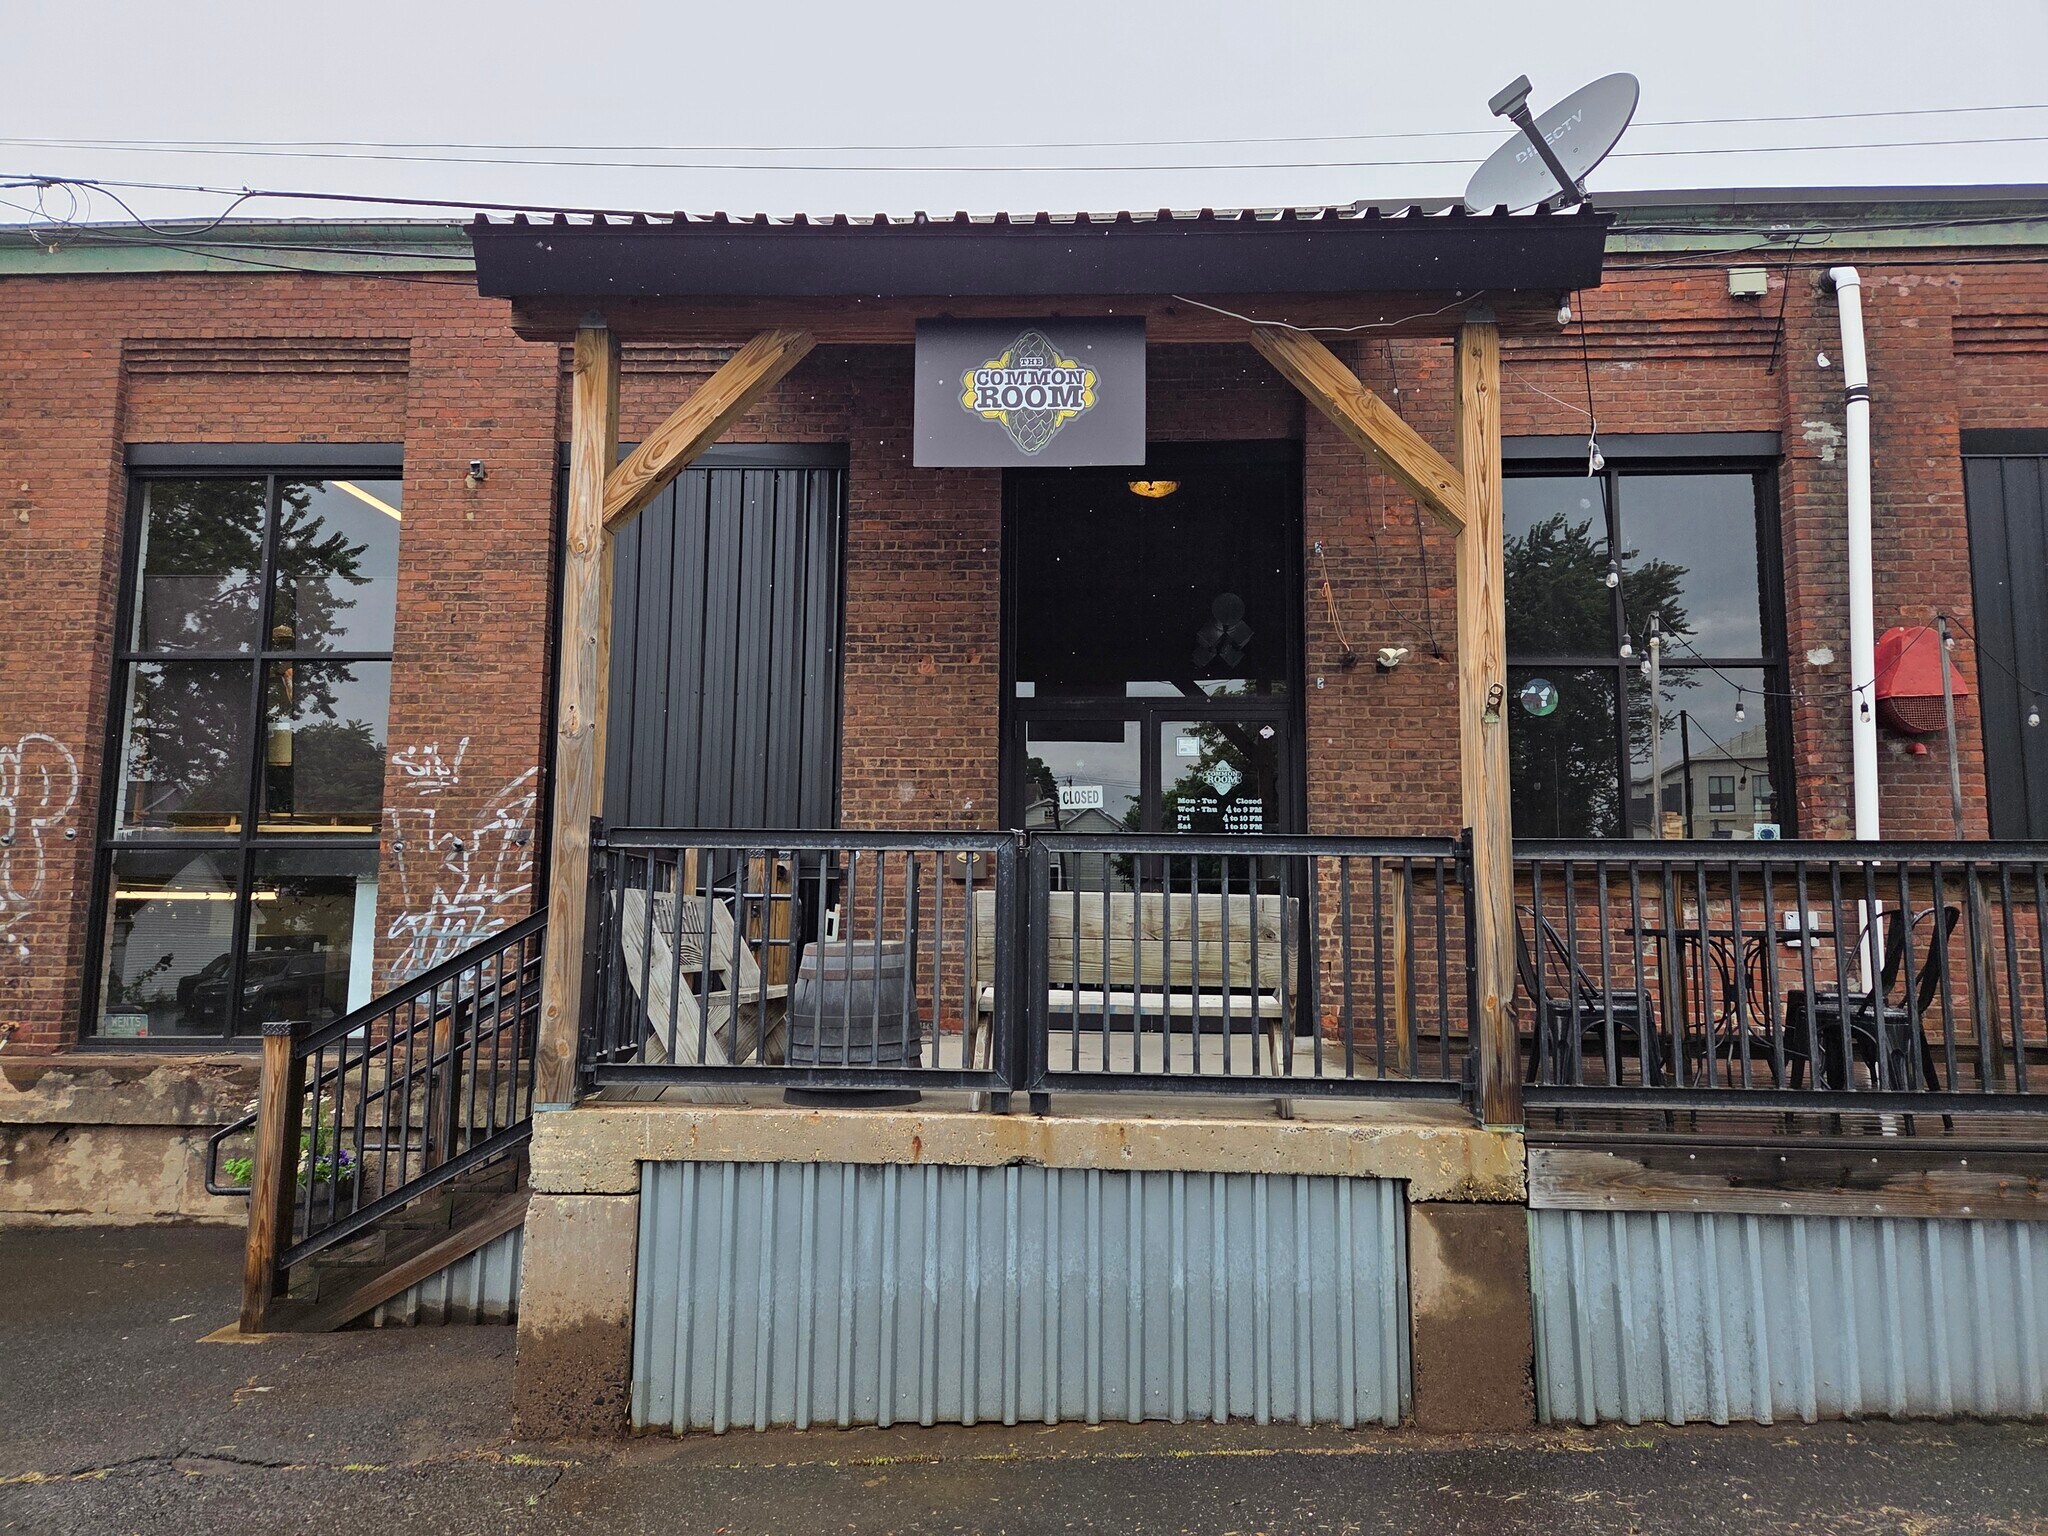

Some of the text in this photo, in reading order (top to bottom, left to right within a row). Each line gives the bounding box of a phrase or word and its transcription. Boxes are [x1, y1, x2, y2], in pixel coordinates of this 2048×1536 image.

[1021, 358, 1042, 366] THE
[976, 370, 1085, 386] COMMON
[977, 386, 1084, 408] ROOM
[1063, 790, 1099, 805] CLOSED
[1235, 797, 1263, 805] Closed
[1225, 804, 1232, 814] 4
[1222, 813, 1229, 823] 4
